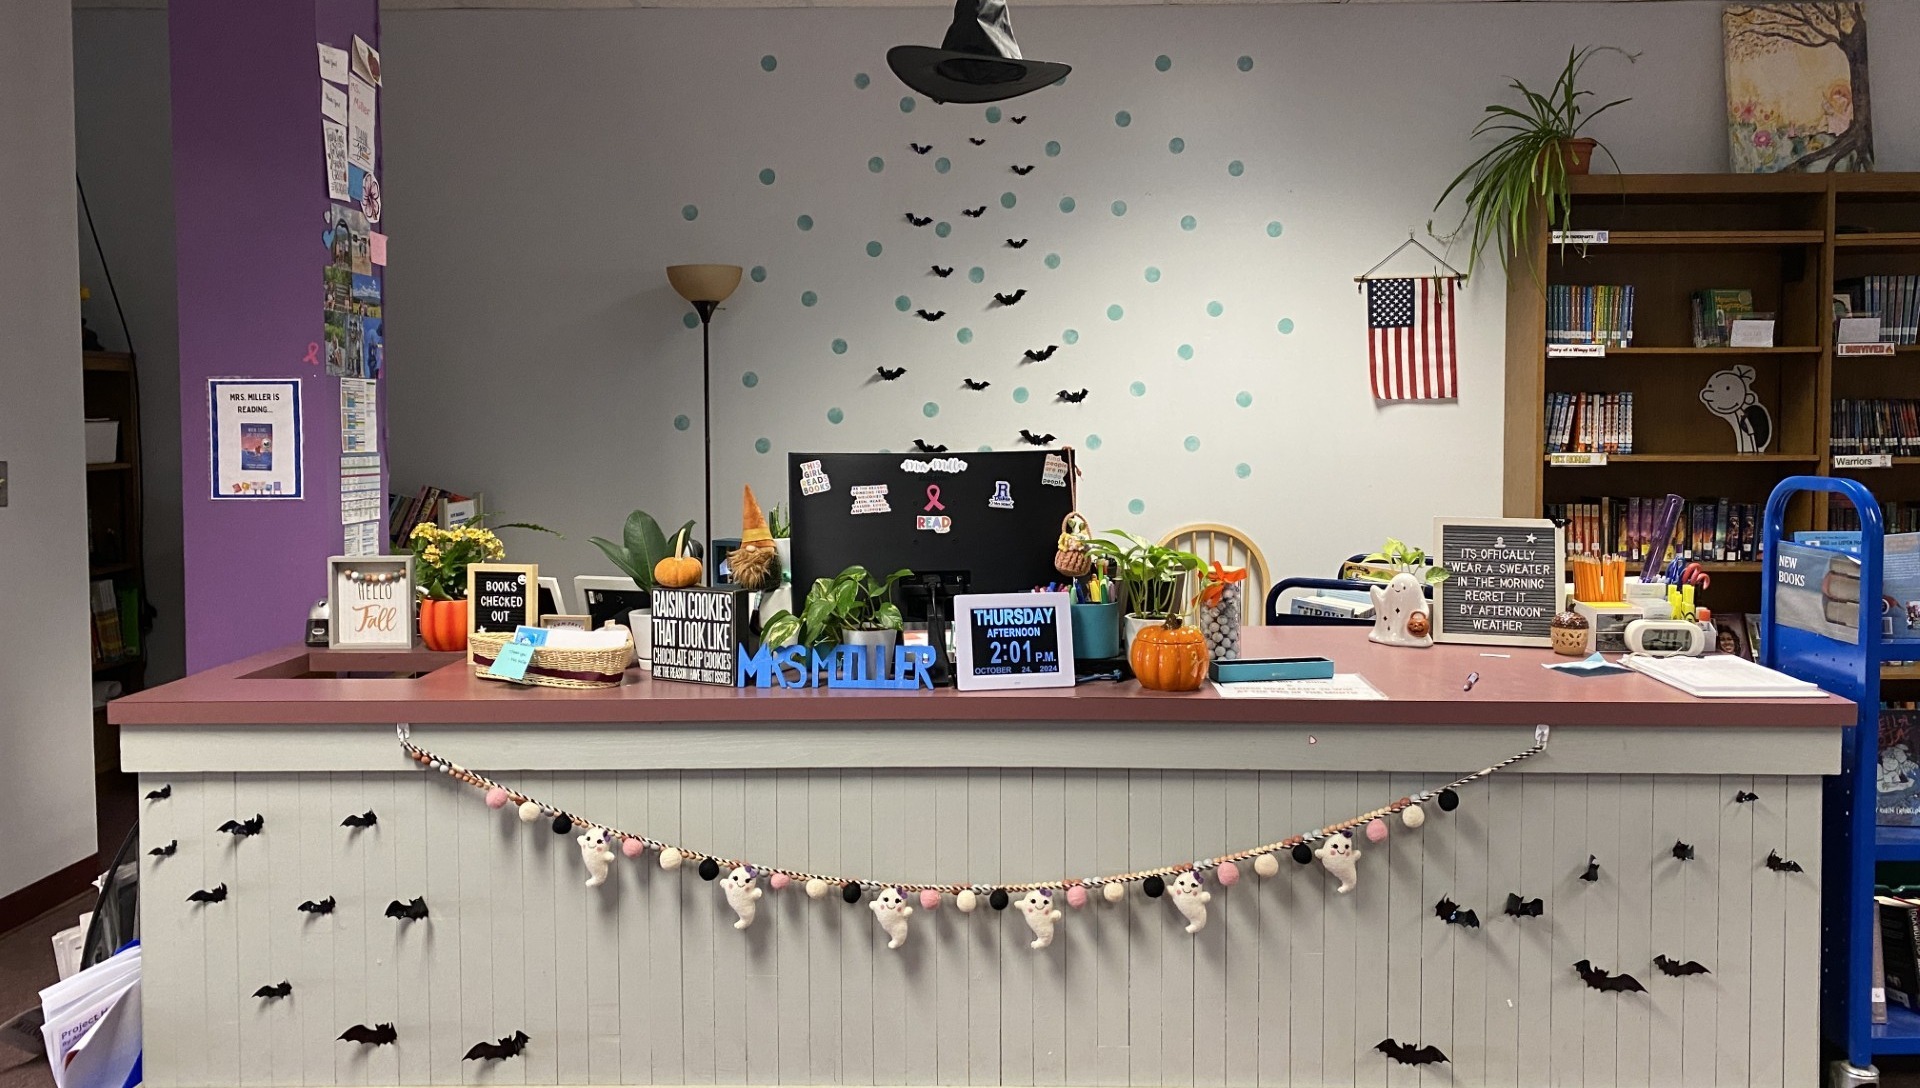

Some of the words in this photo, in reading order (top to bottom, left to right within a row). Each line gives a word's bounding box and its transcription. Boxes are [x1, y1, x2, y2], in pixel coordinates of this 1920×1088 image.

[802, 461, 820, 471] THIS
[804, 469, 822, 478] GIRL
[801, 476, 828, 486] READS
[804, 483, 830, 495] BOOKS
[998, 484, 1008, 496] R
[918, 517, 951, 528] READ
[1462, 548, 1476, 560] ITS
[1481, 549, 1535, 560] OFFICALLY
[1779, 555, 1797, 569] NEW
[1486, 565, 1493, 573] A
[1499, 564, 1550, 574] SWEATER
[1458, 576, 1467, 586] IN
[1474, 577, 1495, 588] THE
[1500, 578, 1544, 589] MORNING
[1779, 571, 1805, 586] BOOKS
[358, 582, 392, 600] HELLO
[486, 581, 517, 592] BOOKS
[481, 596, 523, 607] CHECKED
[1465, 590, 1505, 602] REGRET
[1516, 592, 1526, 602] IT
[653, 590, 686, 618] RAISIN
[688, 592, 731, 621] COOKIES
[1460, 604, 1473, 615] BY
[352, 604, 396, 632] Fall
[491, 611, 510, 623] OUT
[974, 608, 1054, 626] THURSDAY
[1473, 619, 1522, 630] WEATHER
[653, 619, 677, 646] THAT
[679, 621, 706, 649] LOOK
[708, 623, 730, 651] LIKE
[987, 627, 1040, 638] AFTERNOON
[990, 640, 1031, 663] 2:01
[1036, 652, 1056, 662] P.M.
[653, 647, 687, 666] CHOCOLATE
[688, 650, 703, 667] CHIP
[704, 652, 731, 670] COOKIES
[738, 642, 807, 688] MRS
[812, 645, 936, 690] MILLER
[653, 665, 661, 677] ARE
[670, 667, 686, 679] REASON
[701, 670, 715, 682] TRUST
[715, 671, 730, 684] ISSUES
[62, 1014, 99, 1039] Project
